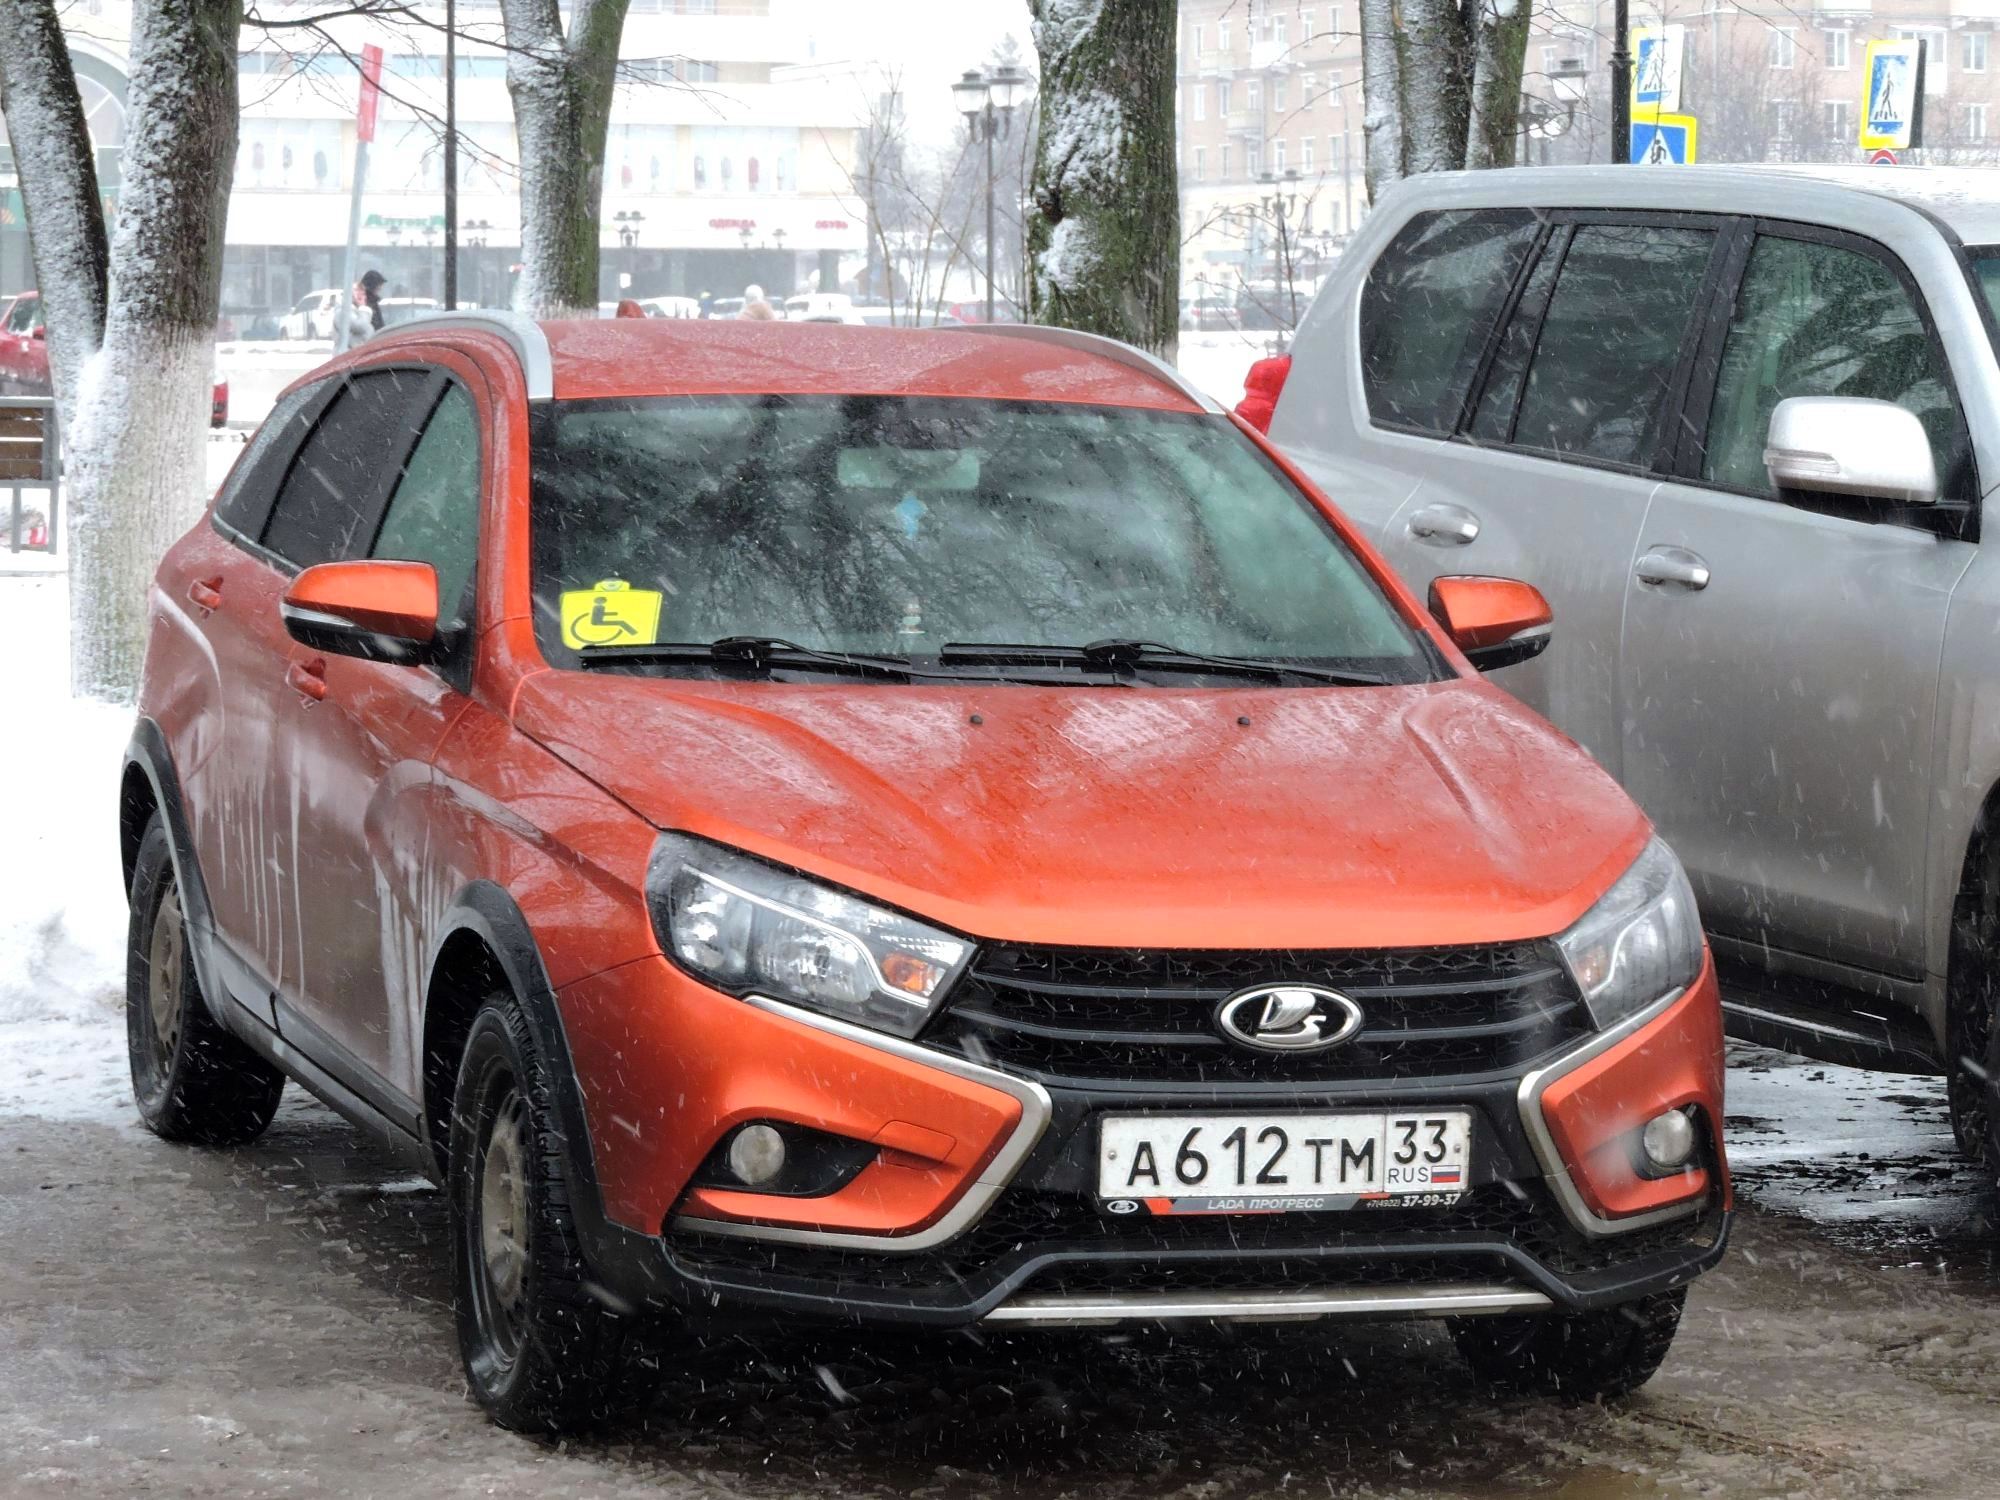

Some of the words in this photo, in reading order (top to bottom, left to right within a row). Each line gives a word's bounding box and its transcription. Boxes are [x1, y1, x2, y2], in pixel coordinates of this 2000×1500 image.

[1127, 1126, 1375, 1186] А612ТМ
[1393, 1119, 1447, 1164] 33
[1388, 1167, 1429, 1184] RUS
[1208, 1199, 1245, 1209] LADA
[1249, 1198, 1324, 1209] ПРОГРЕСС
[1402, 1193, 1461, 1207] 37-99-37
